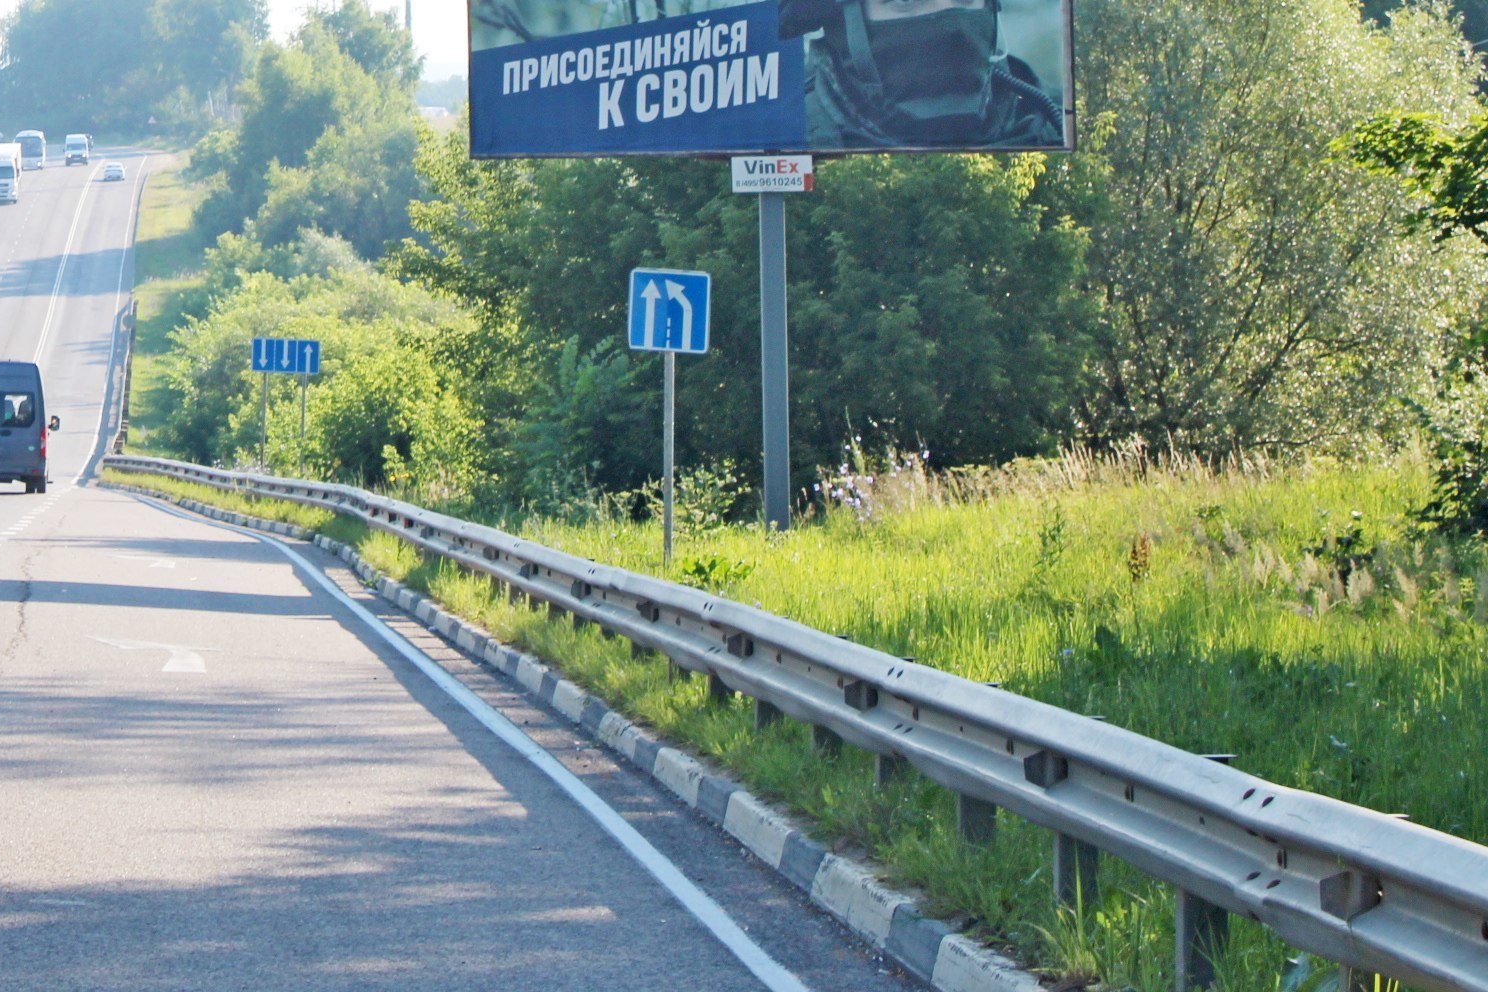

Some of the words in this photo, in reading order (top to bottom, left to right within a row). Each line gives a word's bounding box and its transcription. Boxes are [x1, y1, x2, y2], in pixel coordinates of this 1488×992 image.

[503, 18, 748, 96] ПРИСОЕДИНЯЙСЯ
[598, 78, 625, 131] К
[636, 51, 780, 124] СВОИМ
[744, 159, 799, 175] VinEx
